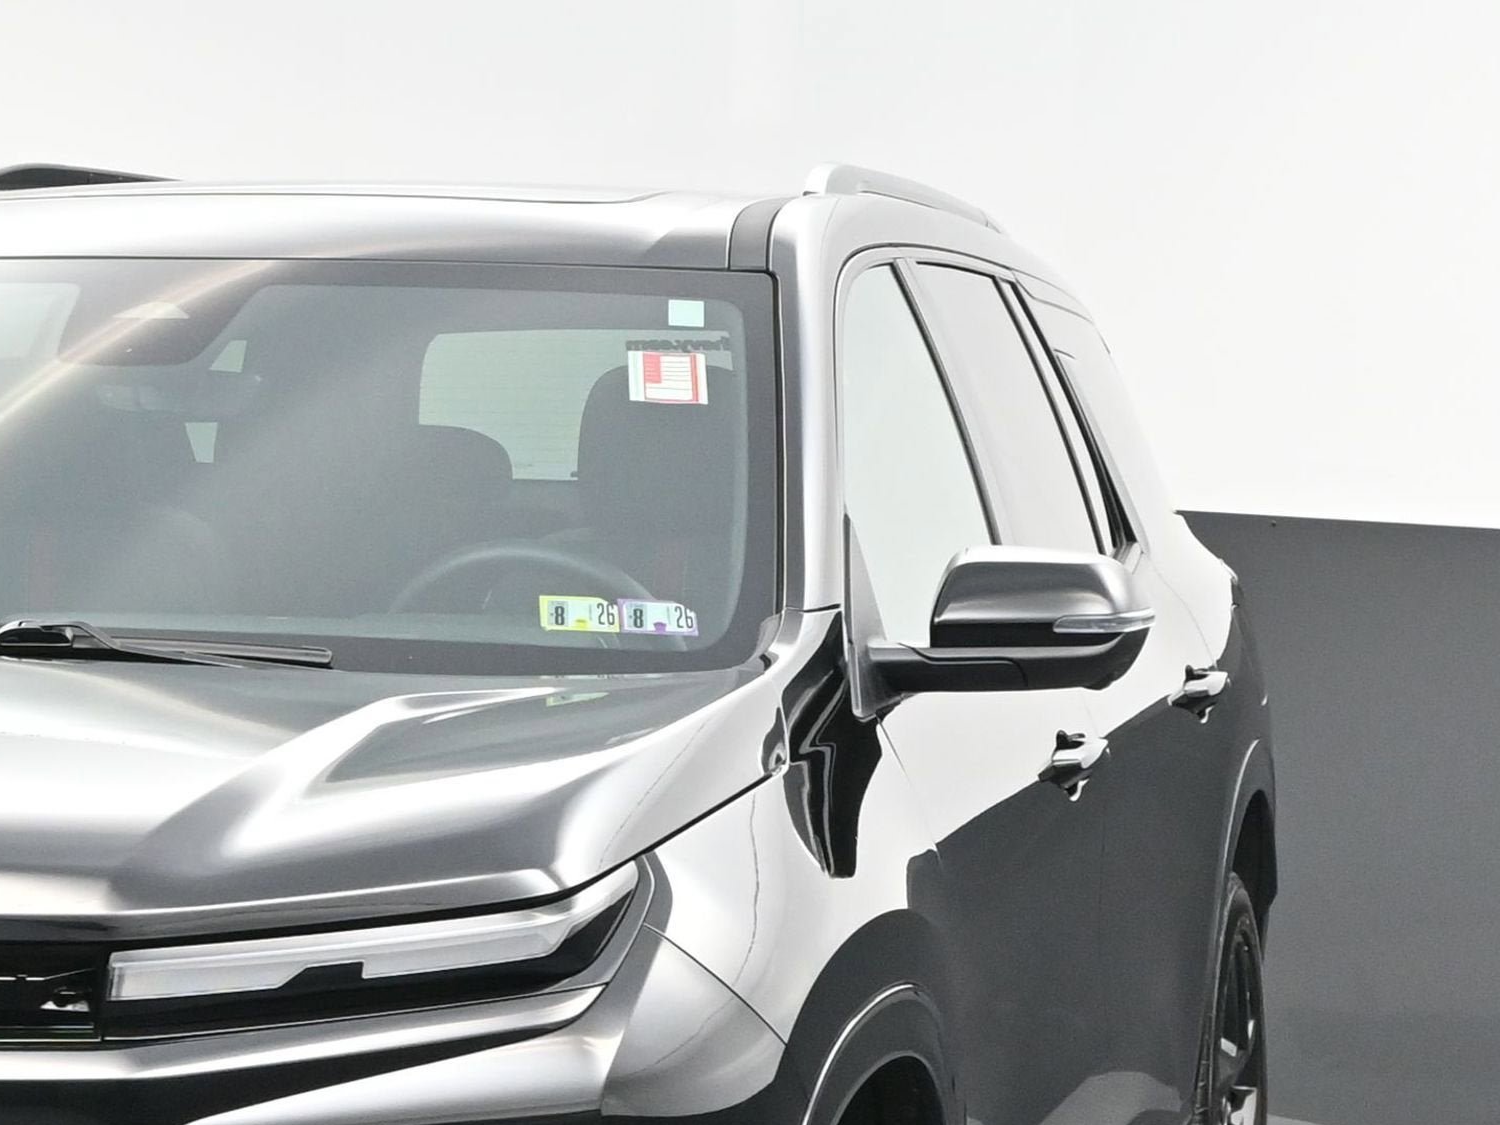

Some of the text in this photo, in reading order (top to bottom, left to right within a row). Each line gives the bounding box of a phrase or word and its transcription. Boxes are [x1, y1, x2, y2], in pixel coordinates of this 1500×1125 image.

[554, 606, 565, 625] 8
[596, 603, 615, 625] 26
[633, 608, 644, 628] 8
[675, 606, 694, 628] 26
